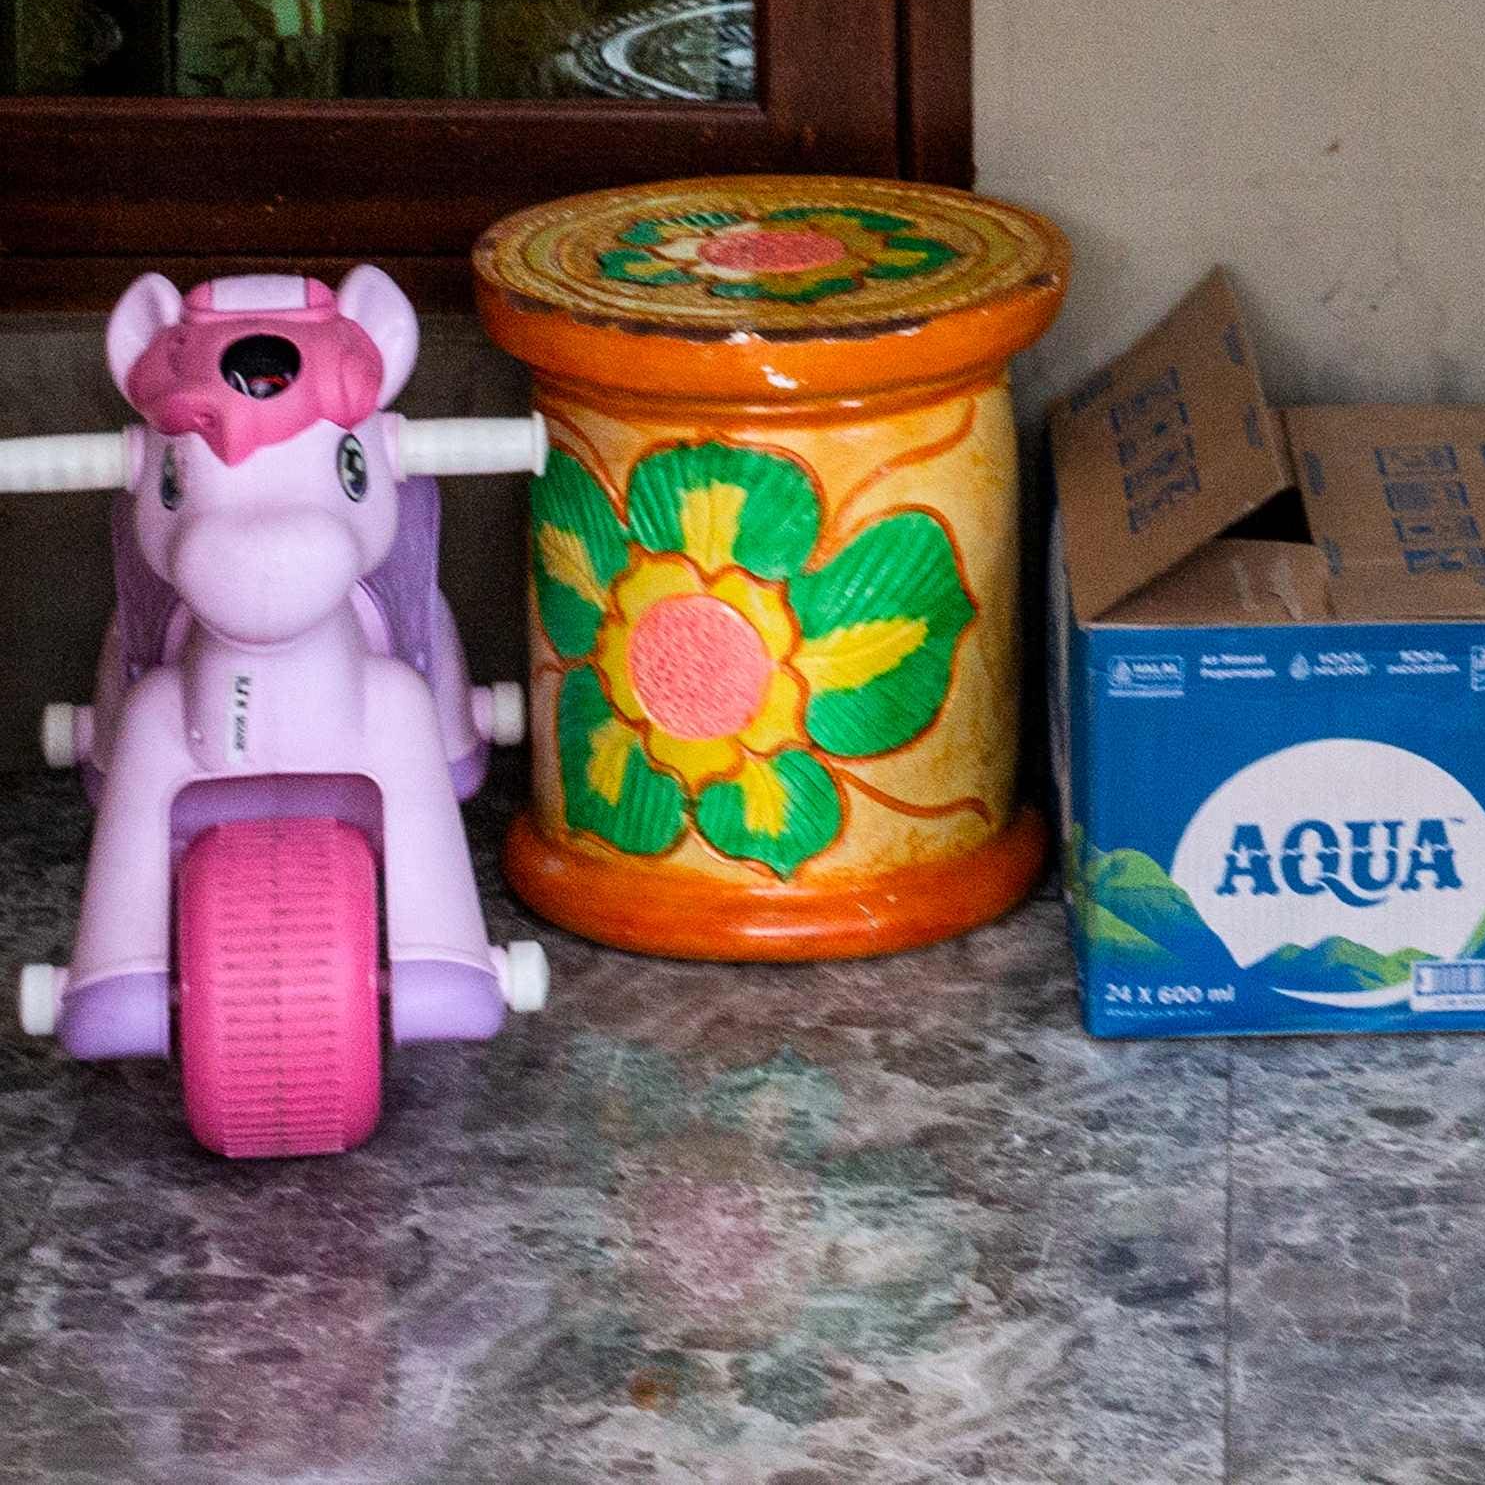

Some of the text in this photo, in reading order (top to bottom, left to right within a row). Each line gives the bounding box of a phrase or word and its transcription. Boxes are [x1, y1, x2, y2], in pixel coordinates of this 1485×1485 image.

[1216, 818, 1464, 908] AQUA
[1105, 982, 1132, 1004] 24
[1157, 985, 1203, 1005] 600
